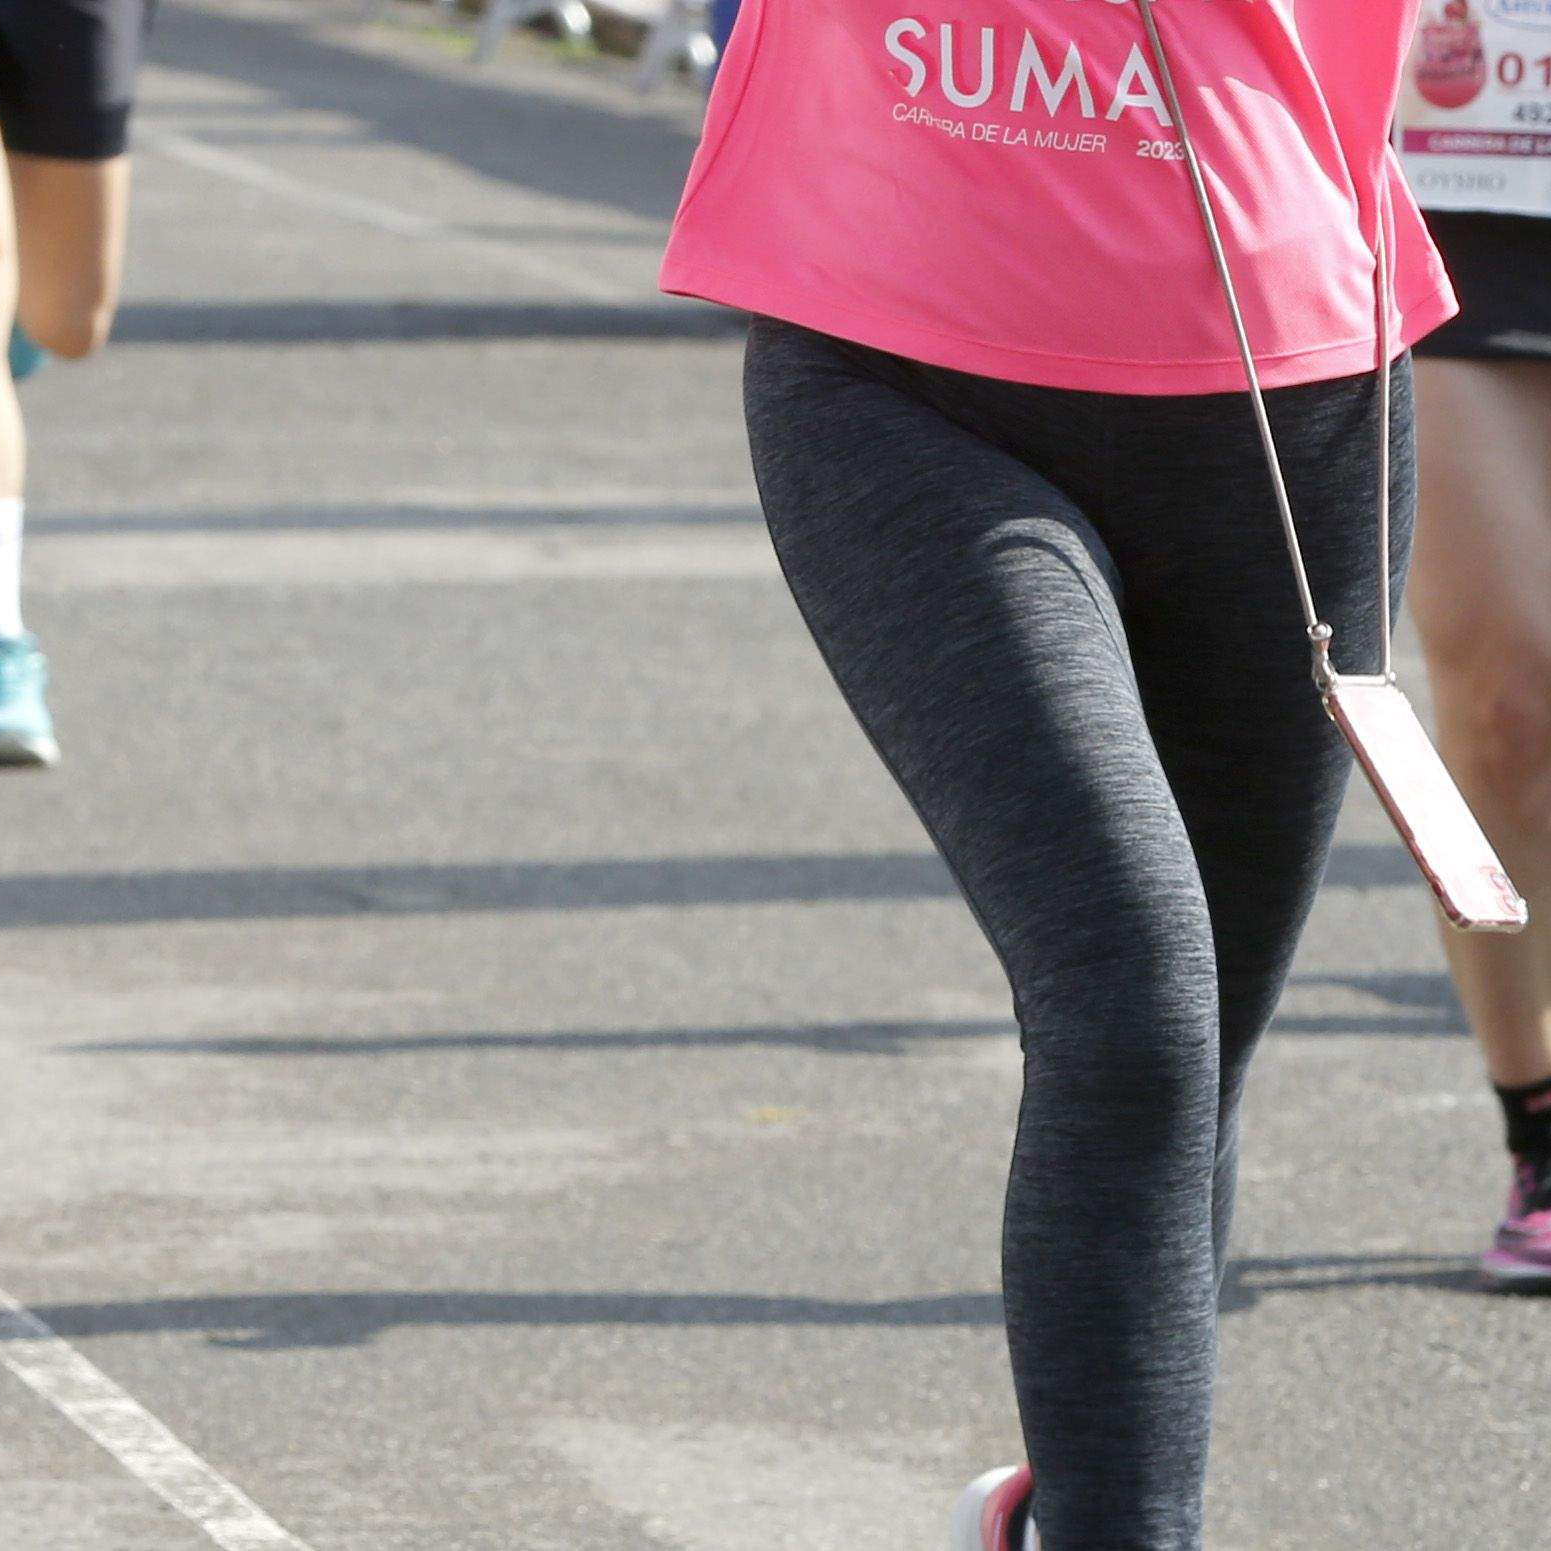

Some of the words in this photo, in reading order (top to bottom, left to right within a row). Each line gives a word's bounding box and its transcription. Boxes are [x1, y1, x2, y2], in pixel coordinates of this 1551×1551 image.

[884, 17, 1175, 128] SUMA
[971, 122, 1000, 144] DE
[1002, 125, 1029, 148] LA
[1033, 131, 1107, 154] MUJER
[1135, 139, 1187, 161] 2023
